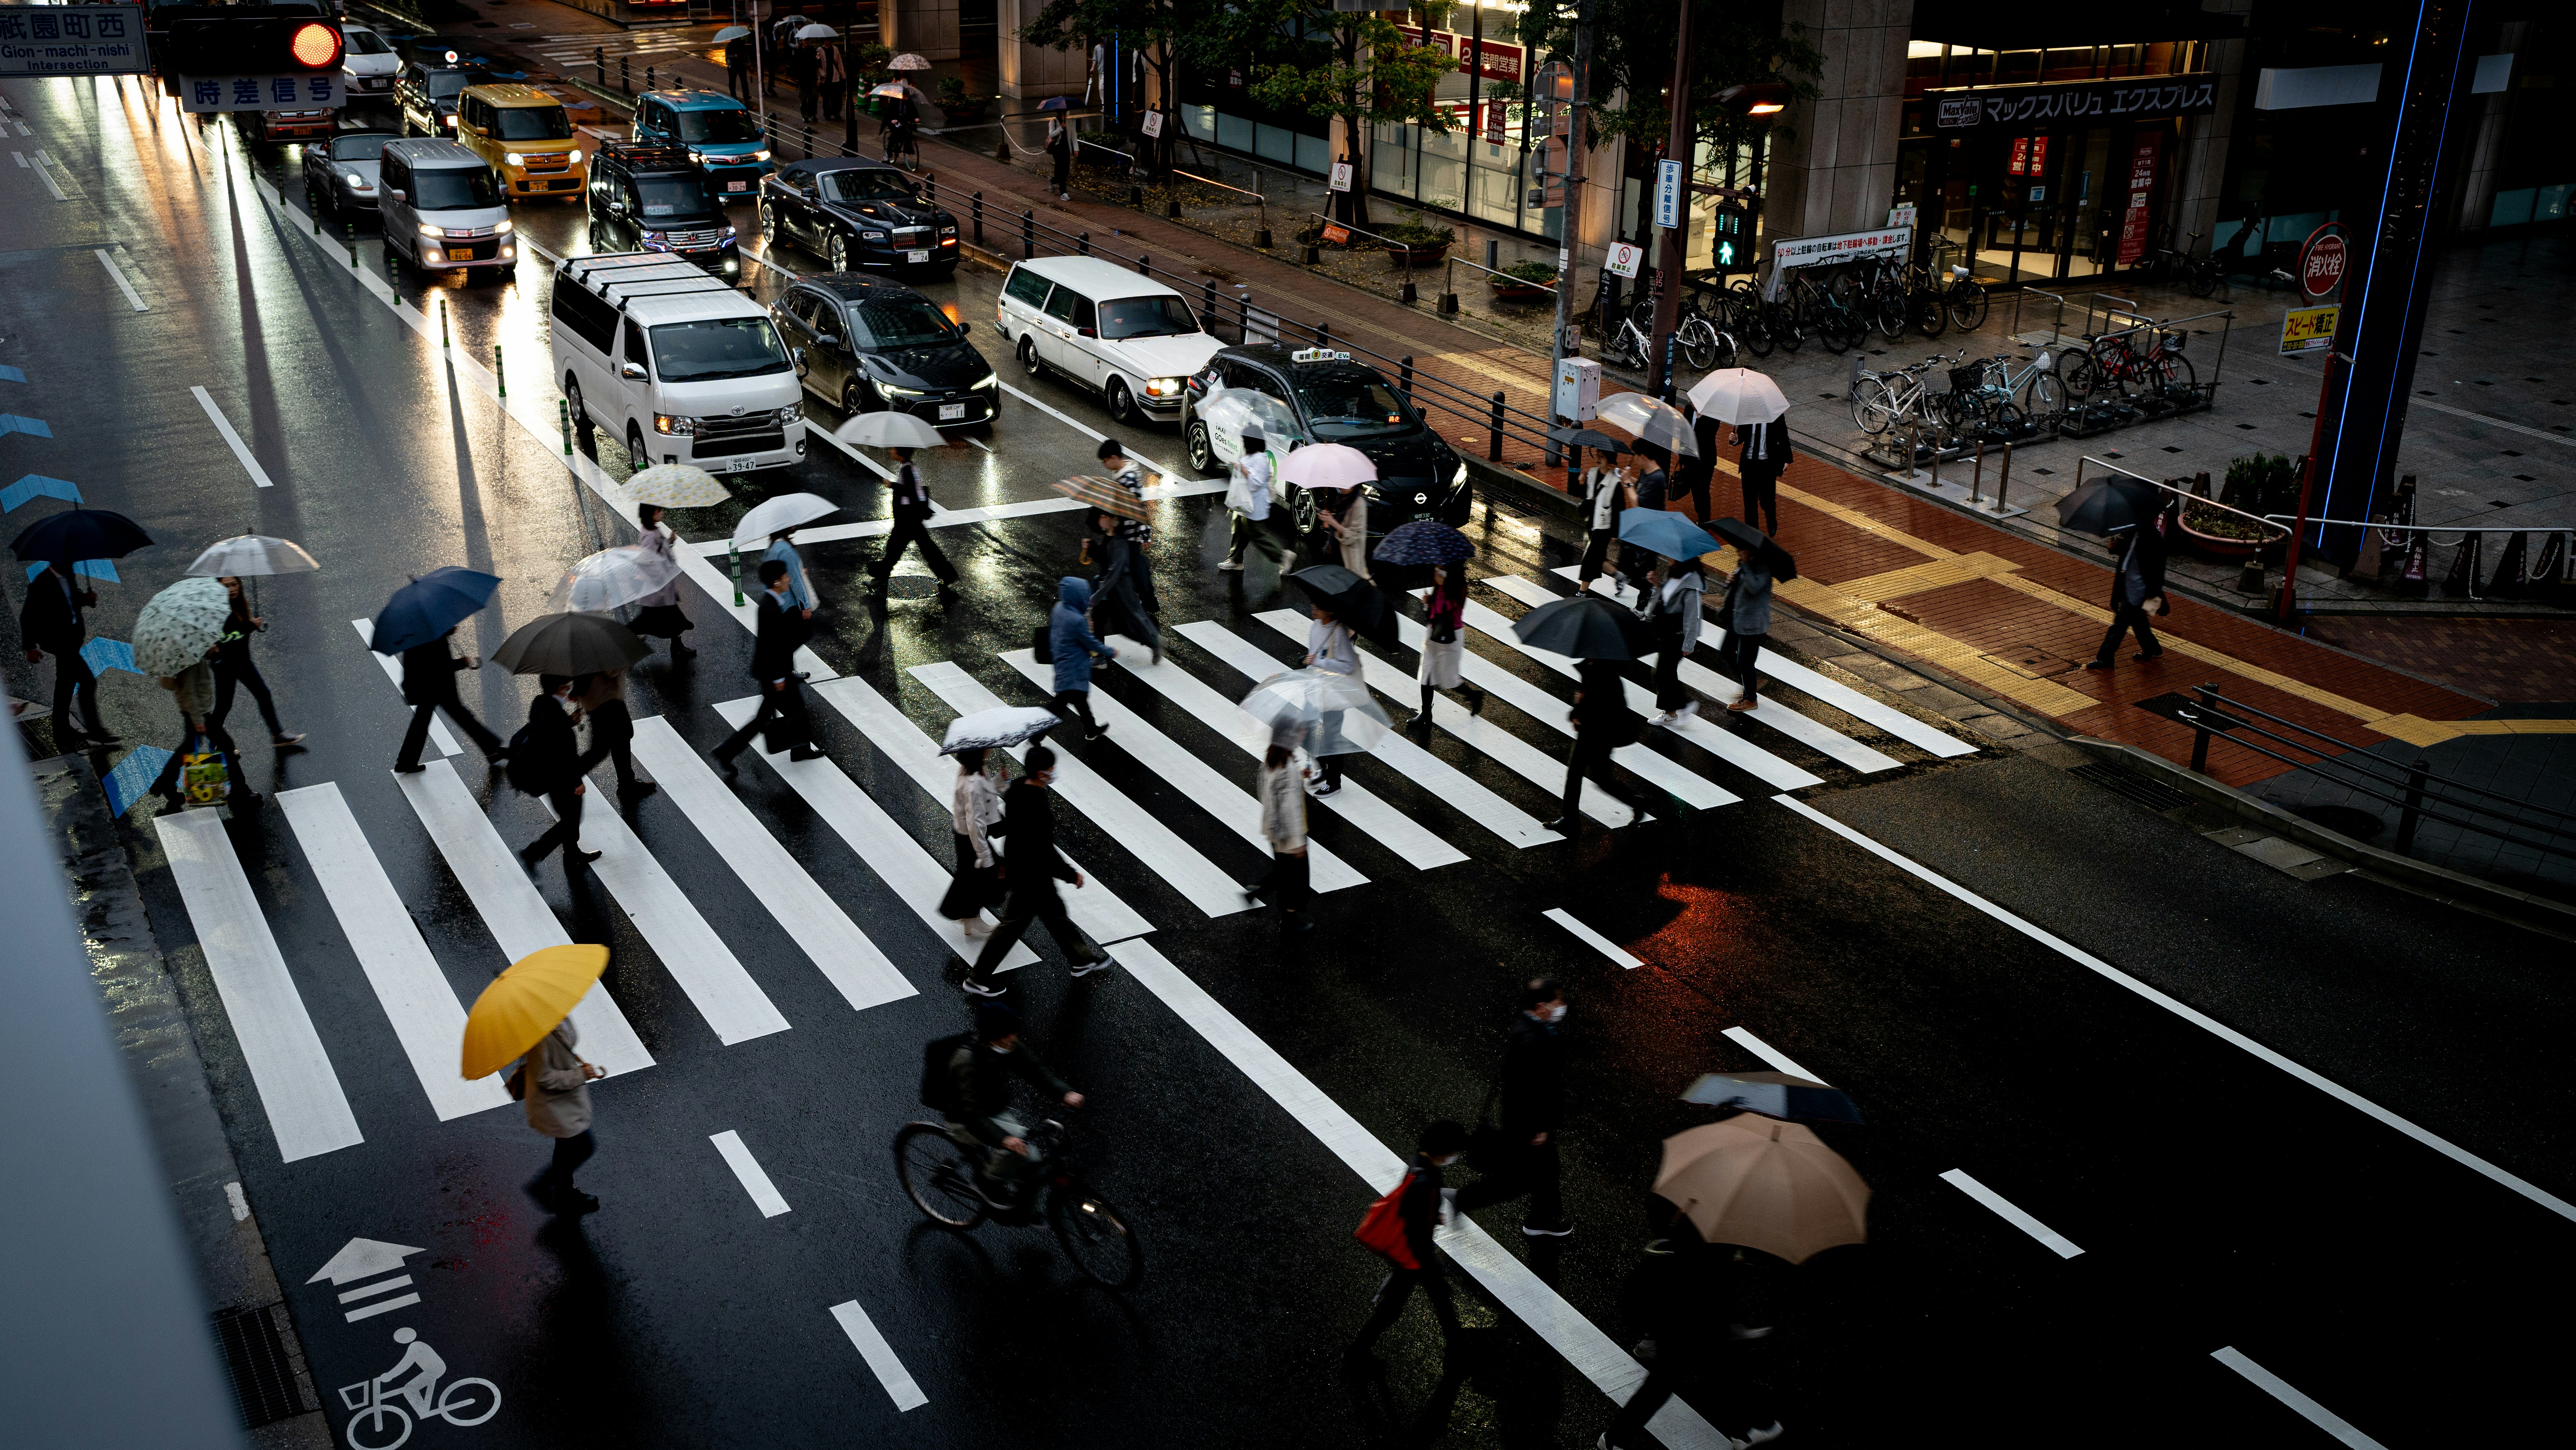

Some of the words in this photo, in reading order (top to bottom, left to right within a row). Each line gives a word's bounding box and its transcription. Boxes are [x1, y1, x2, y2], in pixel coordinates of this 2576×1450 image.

[28, 60, 108, 70] Intersection
[1462, 47, 1518, 74] 2時間営業
[194, 77, 333, 105] 時差信号
[1943, 96, 1978, 116] MaxValu
[1986, 92, 2102, 122] マックスバリュ
[2110, 84, 2213, 112] エクスプレス
[1488, 130, 1504, 142] 営業中
[1490, 122, 1503, 131] 24時間
[2012, 162, 2041, 172] 営中
[2135, 169, 2151, 177] 24時間
[2131, 177, 2152, 189] 営業中
[1663, 164, 1674, 223] 歩車分離信号
[1611, 262, 1631, 272] 駐輪禁止
[2307, 253, 2342, 277] 消火栓
[2286, 313, 2334, 337] スピード矯正
[1216, 423, 1226, 434] TAXI
[1215, 433, 1227, 445] GOes
[1228, 439, 1238, 452] Next.
[733, 462, 754, 471] 39-47
[2391, 512, 2400, 536] 駐輪止
[2411, 547, 2423, 572] 駐輪禁止
